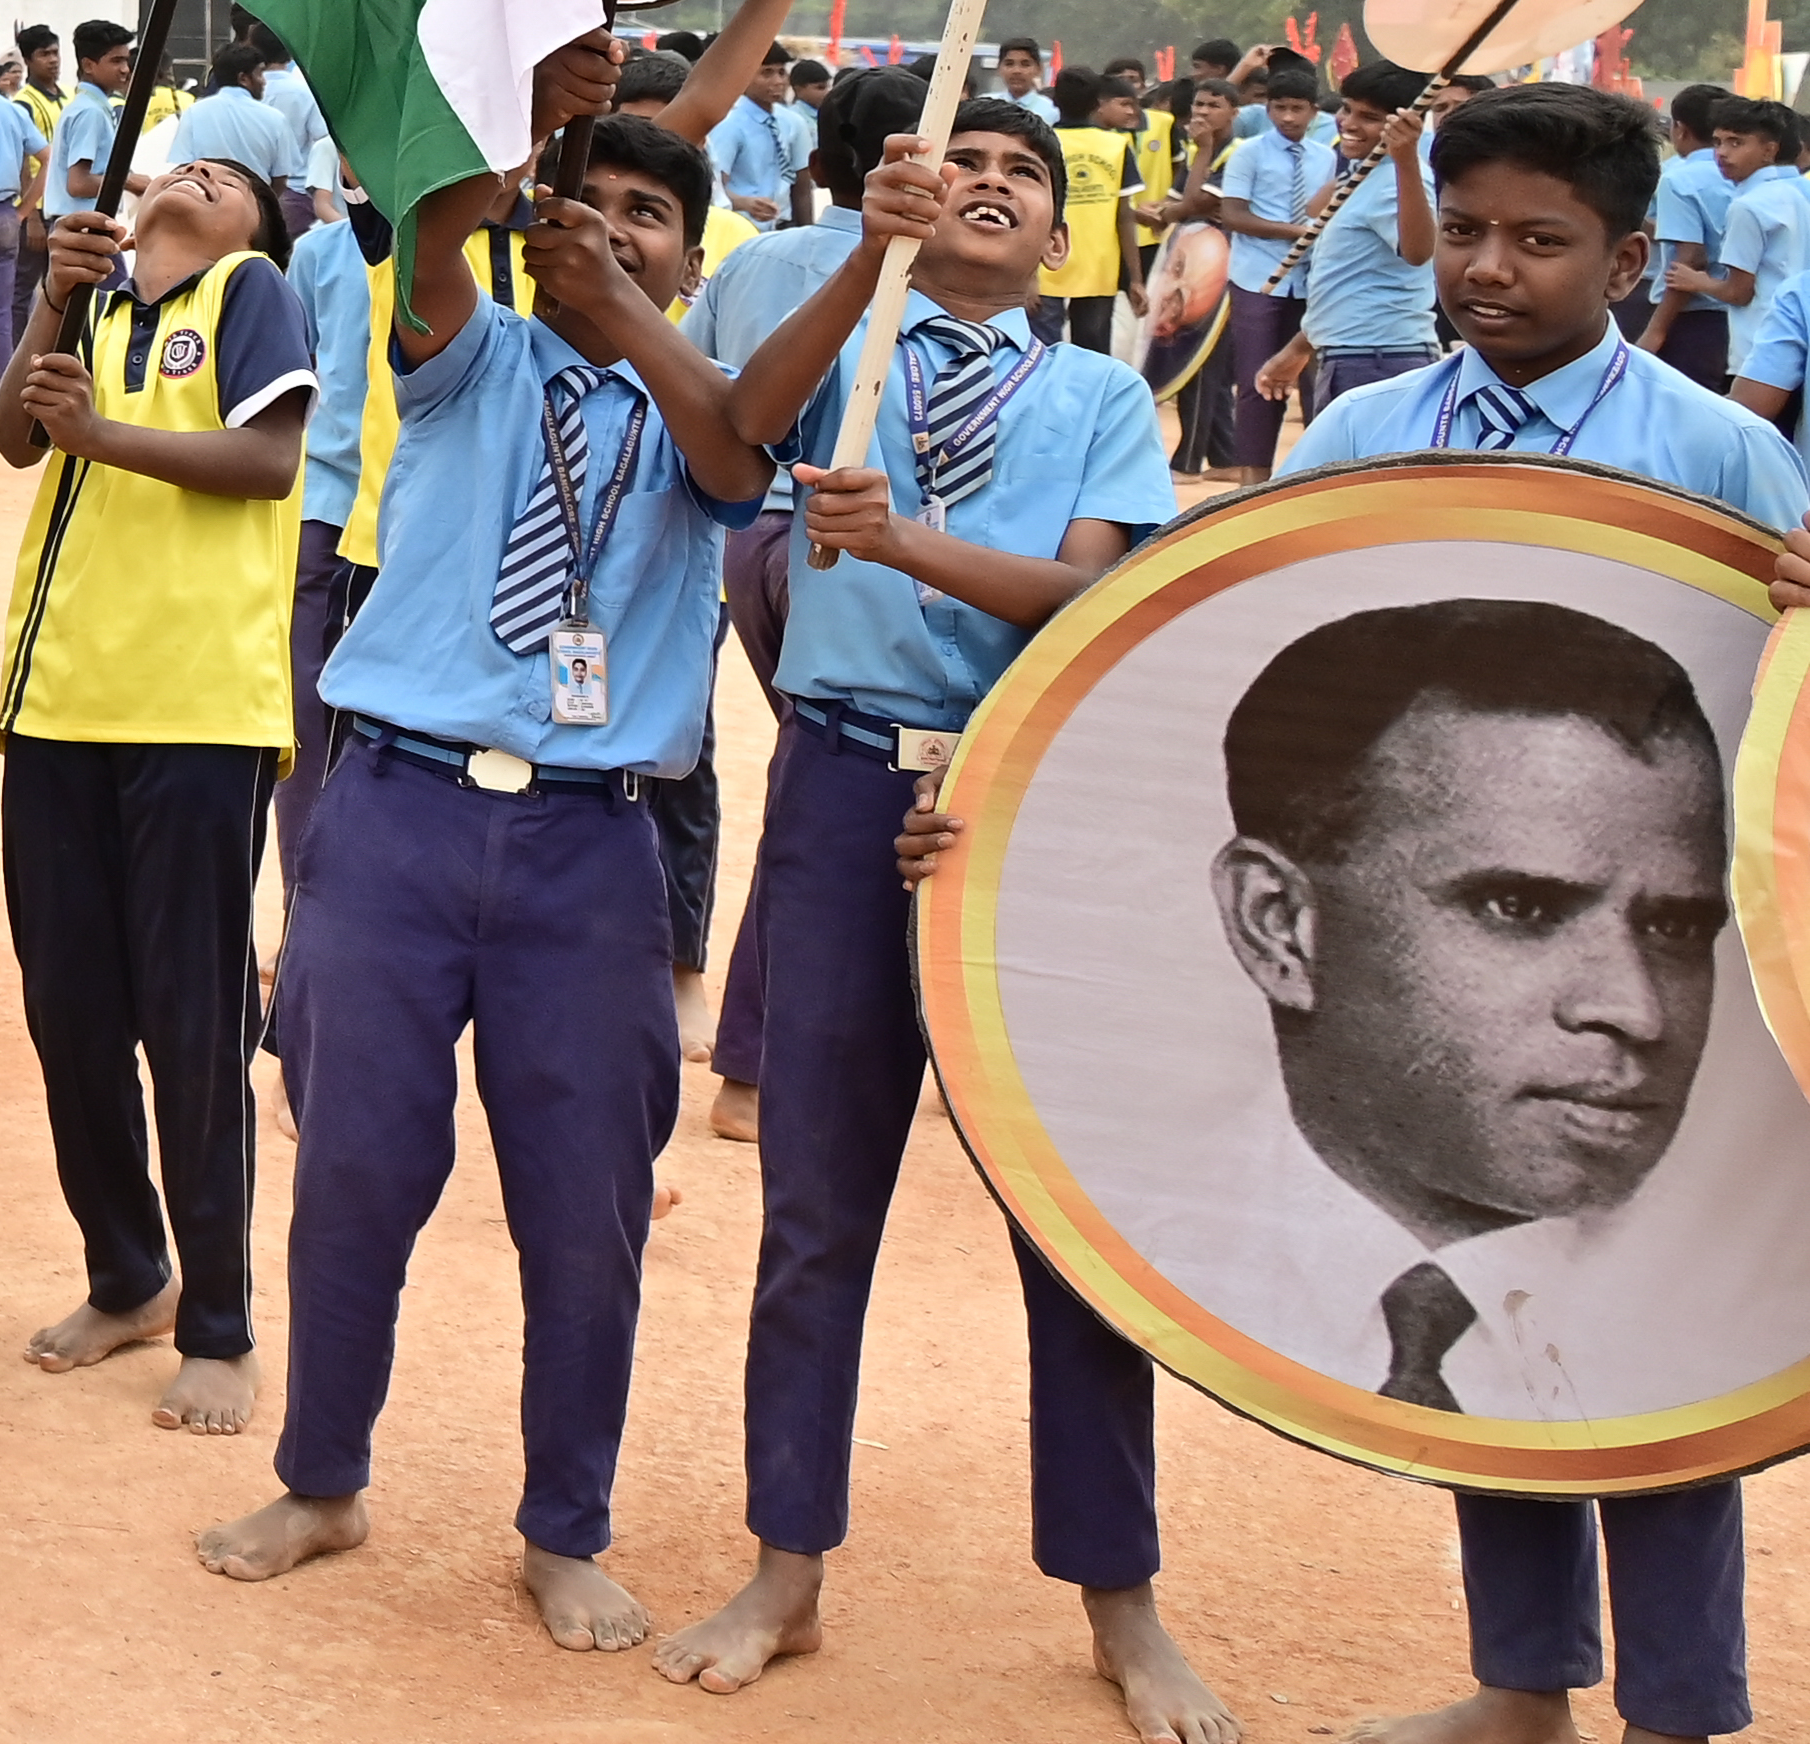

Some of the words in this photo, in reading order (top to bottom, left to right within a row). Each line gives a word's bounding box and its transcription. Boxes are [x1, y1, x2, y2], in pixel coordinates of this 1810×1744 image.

[951, 393, 1001, 449] GOVERNMENT
[555, 465, 577, 523] BANGALORE
[600, 482, 621, 520] SCHOOL
[616, 419, 642, 481] BAGALAGUNTE
